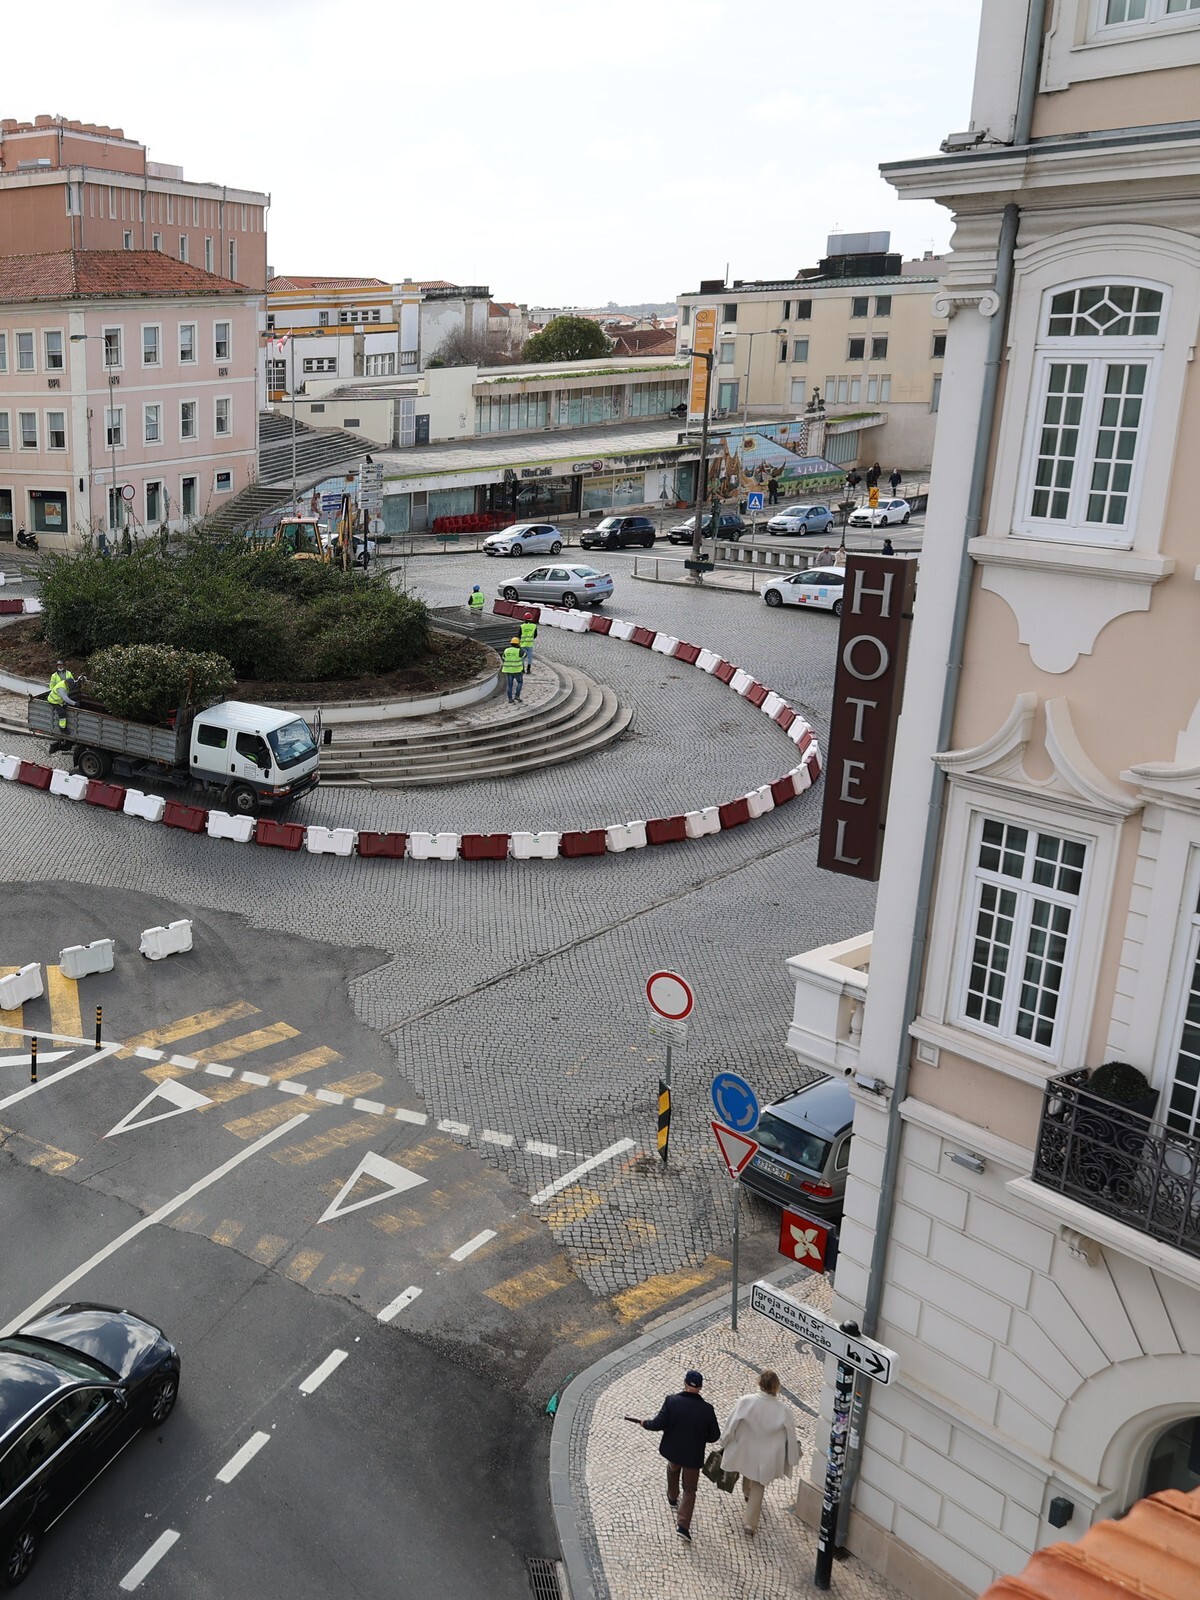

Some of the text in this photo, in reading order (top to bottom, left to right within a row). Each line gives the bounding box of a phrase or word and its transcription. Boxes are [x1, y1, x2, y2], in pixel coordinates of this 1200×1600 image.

[833, 569, 895, 865] HOTEL
[754, 1300, 832, 1348] da Apresentação
[784, 1306, 796, 1318] da
[798, 1312, 809, 1325] N.
